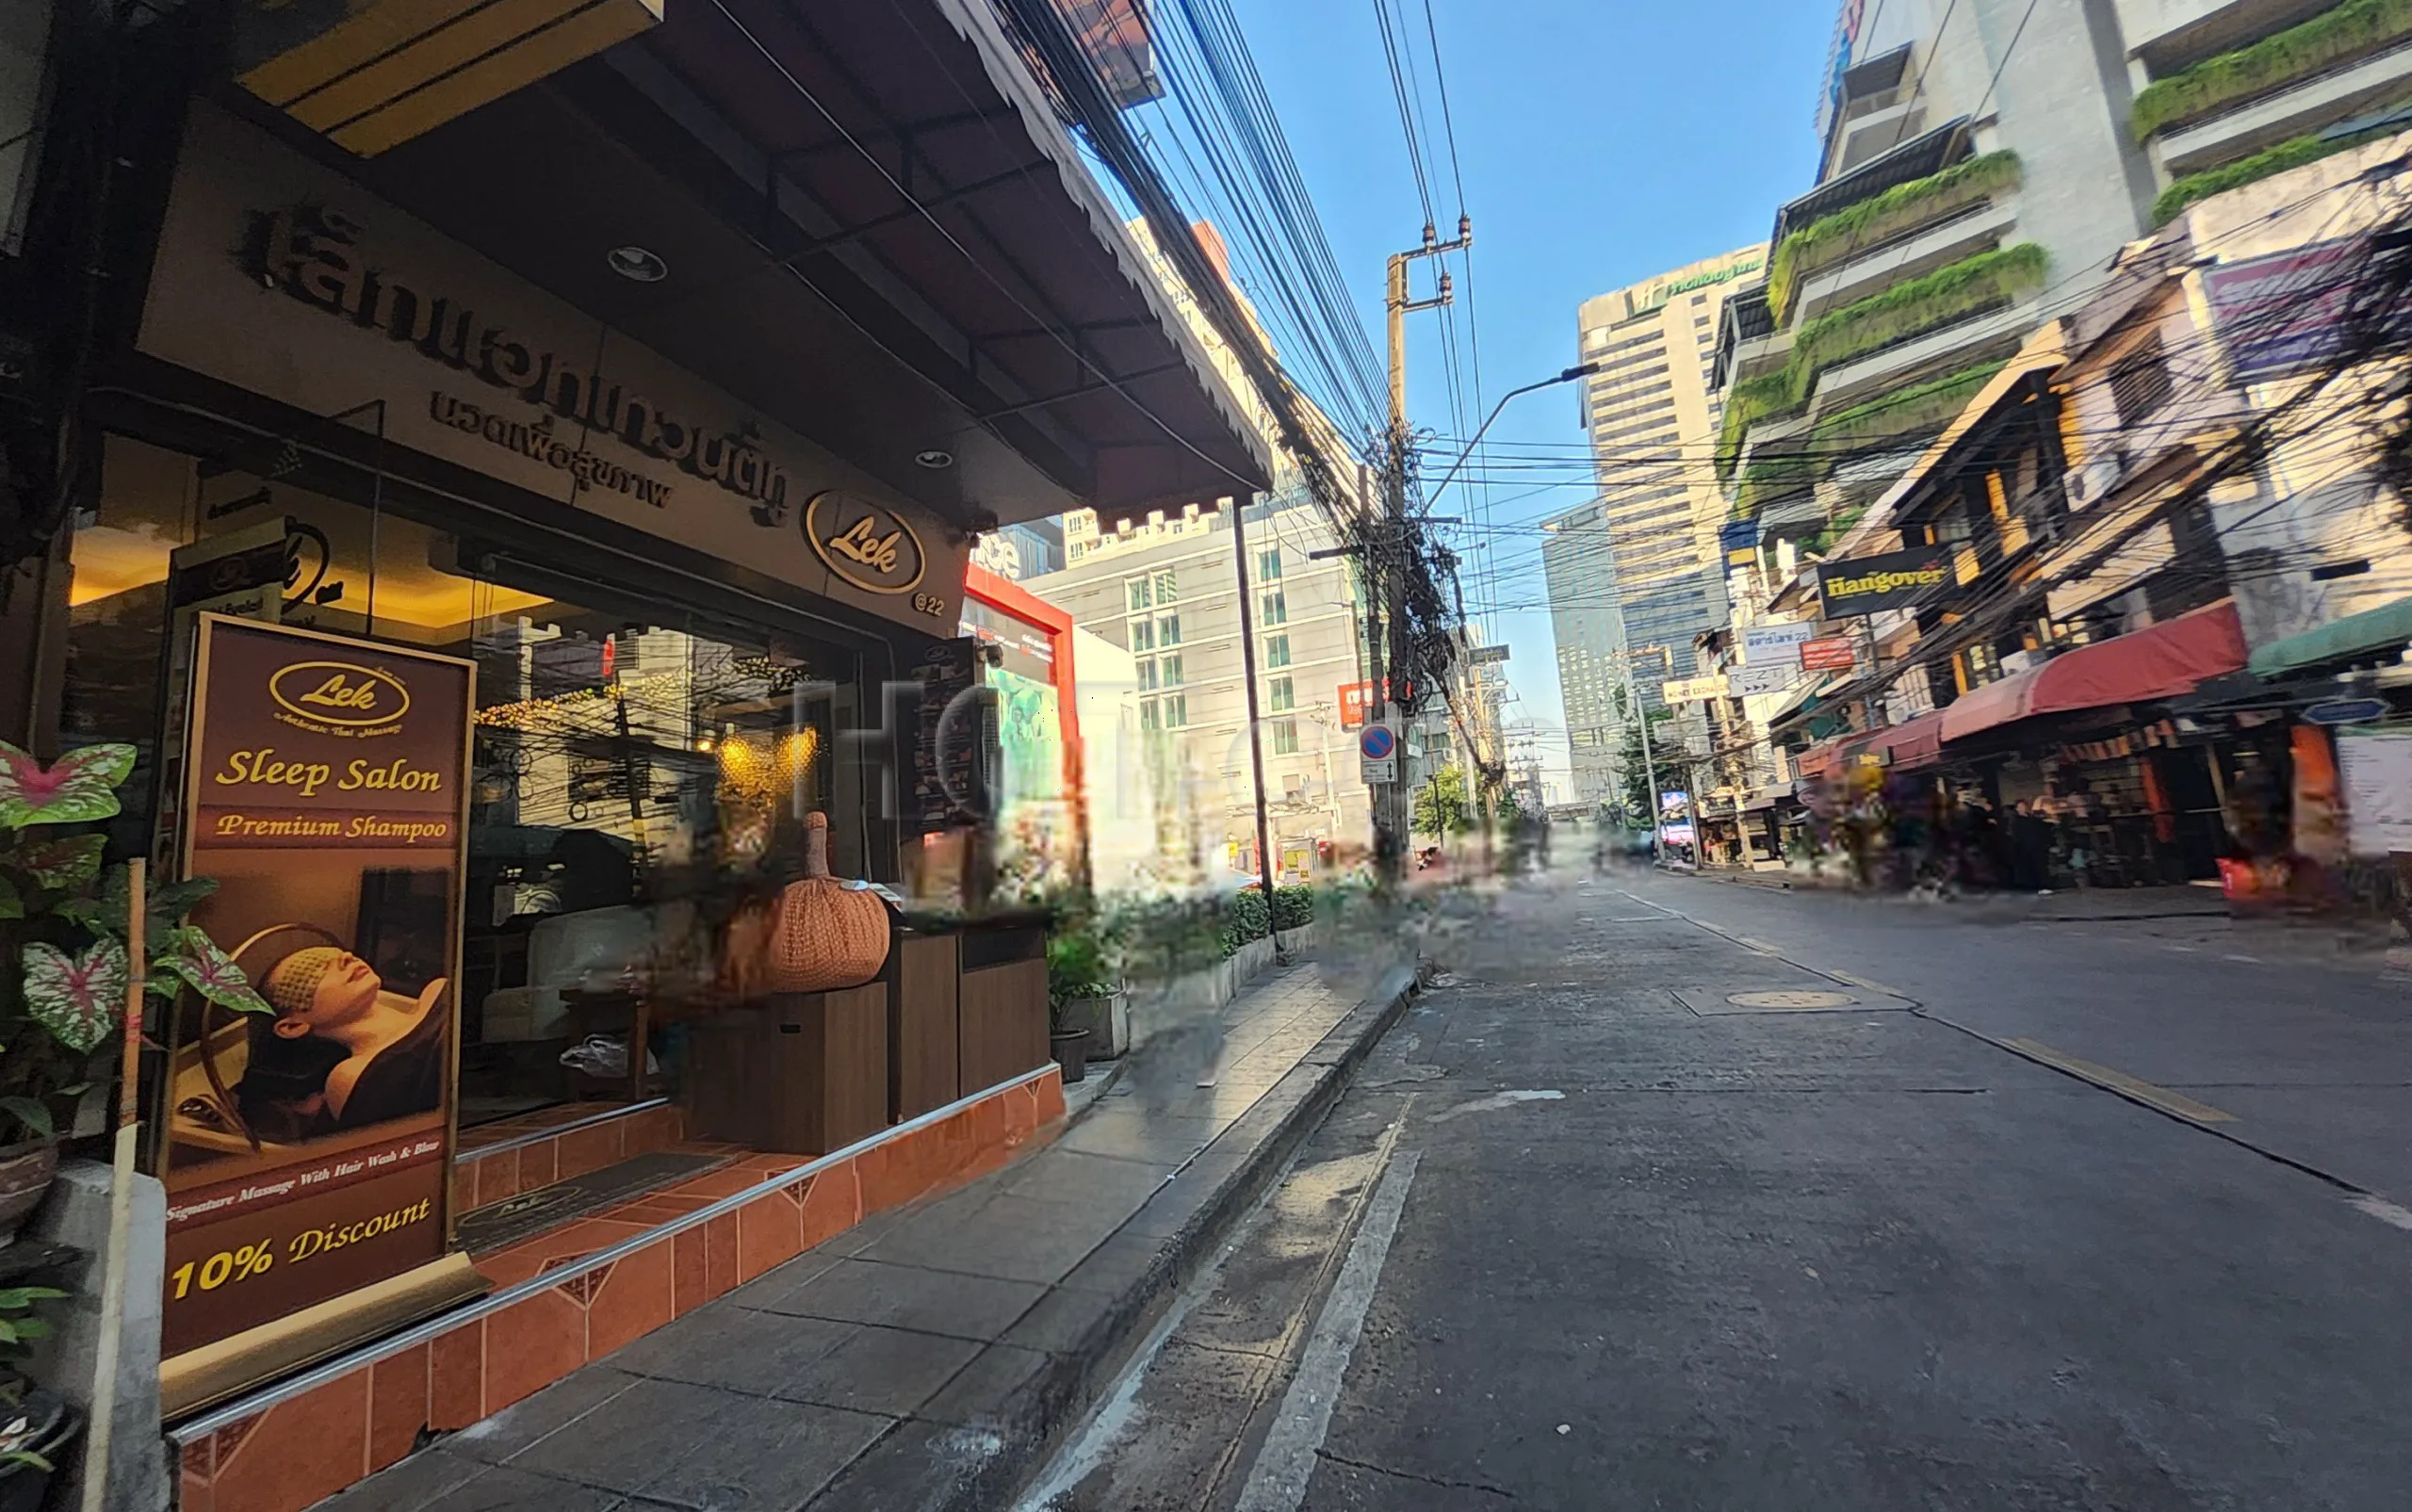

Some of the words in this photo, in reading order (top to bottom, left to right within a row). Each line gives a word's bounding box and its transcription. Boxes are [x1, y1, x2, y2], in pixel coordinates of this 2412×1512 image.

[430, 390, 673, 509] นวดเพื่อสุขภาพ
[829, 516, 901, 573] Lek
[1825, 568, 1947, 597] Hangover
[913, 593, 944, 616] @22
[1794, 631, 1809, 642] 22
[299, 674, 377, 710] Lek
[215, 748, 330, 797] Sleep
[338, 758, 442, 792] Salon
[215, 814, 340, 837] Premium
[345, 816, 448, 843] Shampoo
[165, 1194, 236, 1222] Signature
[237, 1178, 297, 1204] Massage
[300, 1168, 331, 1186] With
[334, 1160, 365, 1179] Hair
[367, 1150, 398, 1168] Wash
[399, 1146, 413, 1160] &
[414, 1140, 441, 1156] Blow
[171, 1238, 275, 1300] 10%
[287, 1197, 432, 1264] Discount
